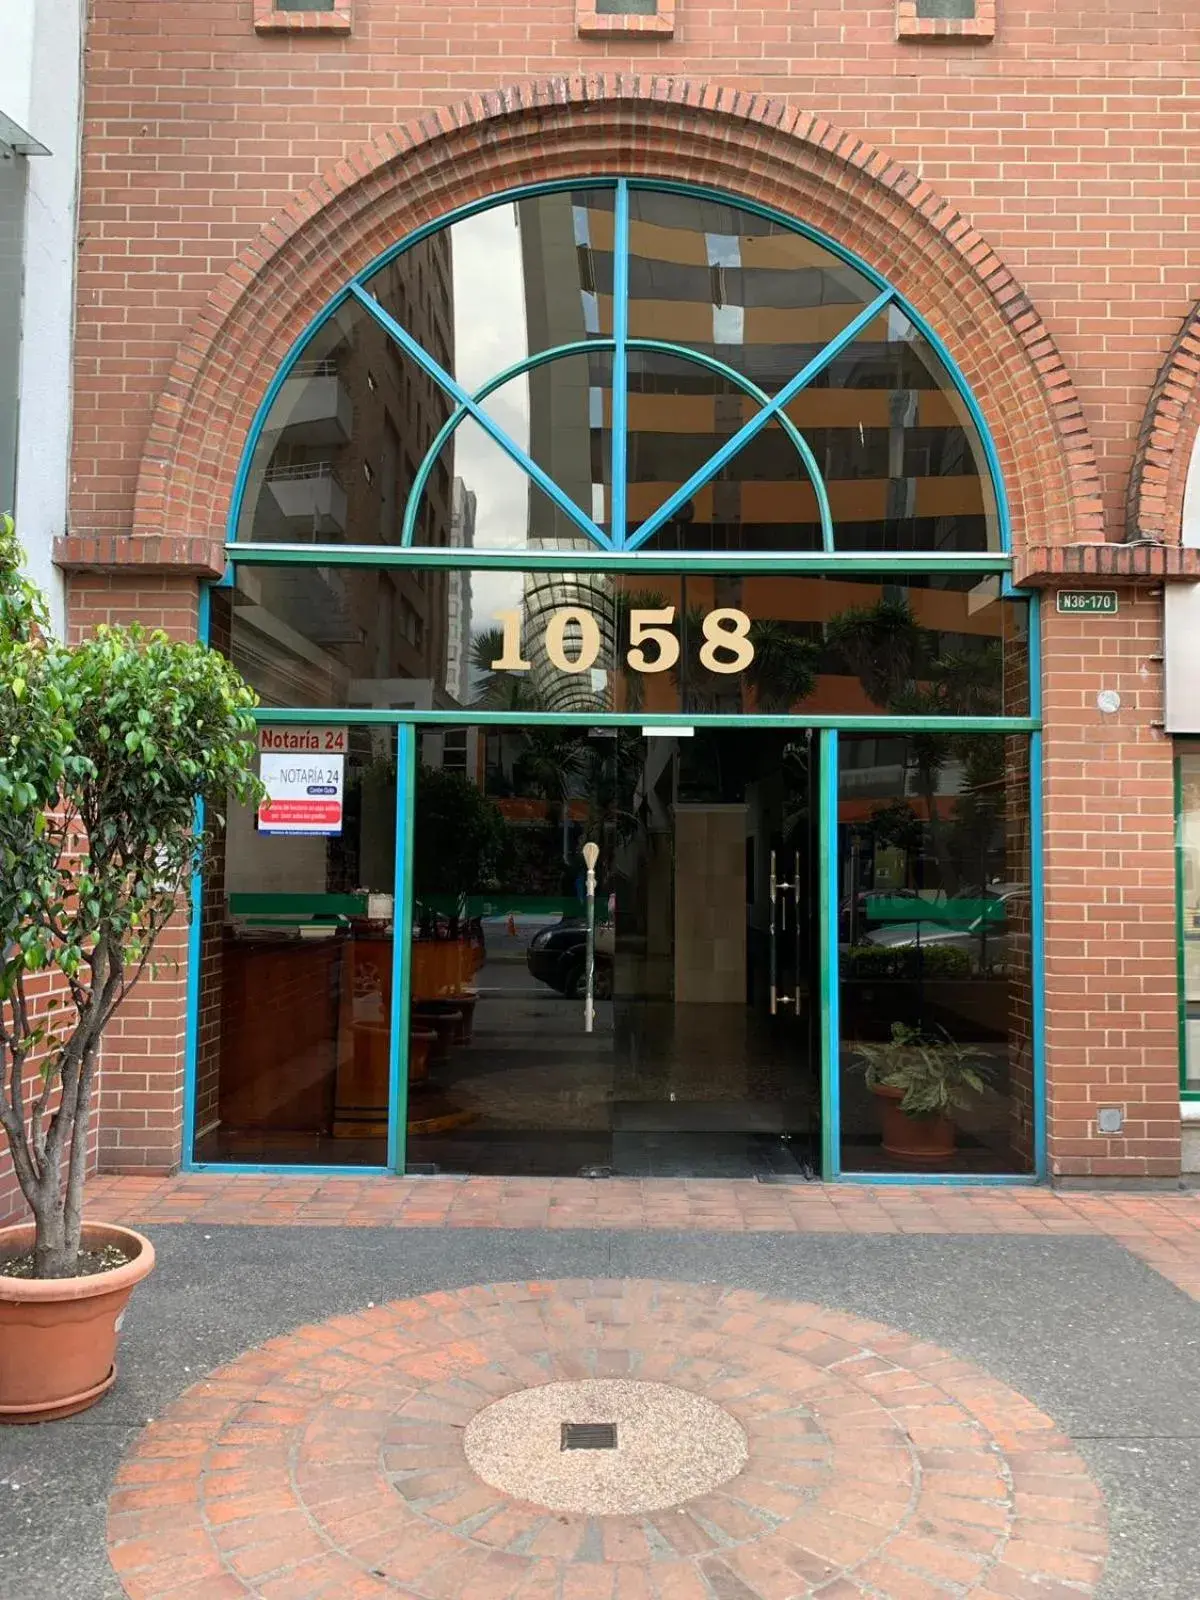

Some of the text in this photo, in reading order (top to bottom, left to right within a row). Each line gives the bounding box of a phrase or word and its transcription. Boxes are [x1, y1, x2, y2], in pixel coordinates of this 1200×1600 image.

[1064, 595, 1111, 608] N36-170
[490, 606, 755, 674] 1058
[261, 729, 344, 749] Notaría 24
[280, 766, 339, 783] NOTARÍA 24
